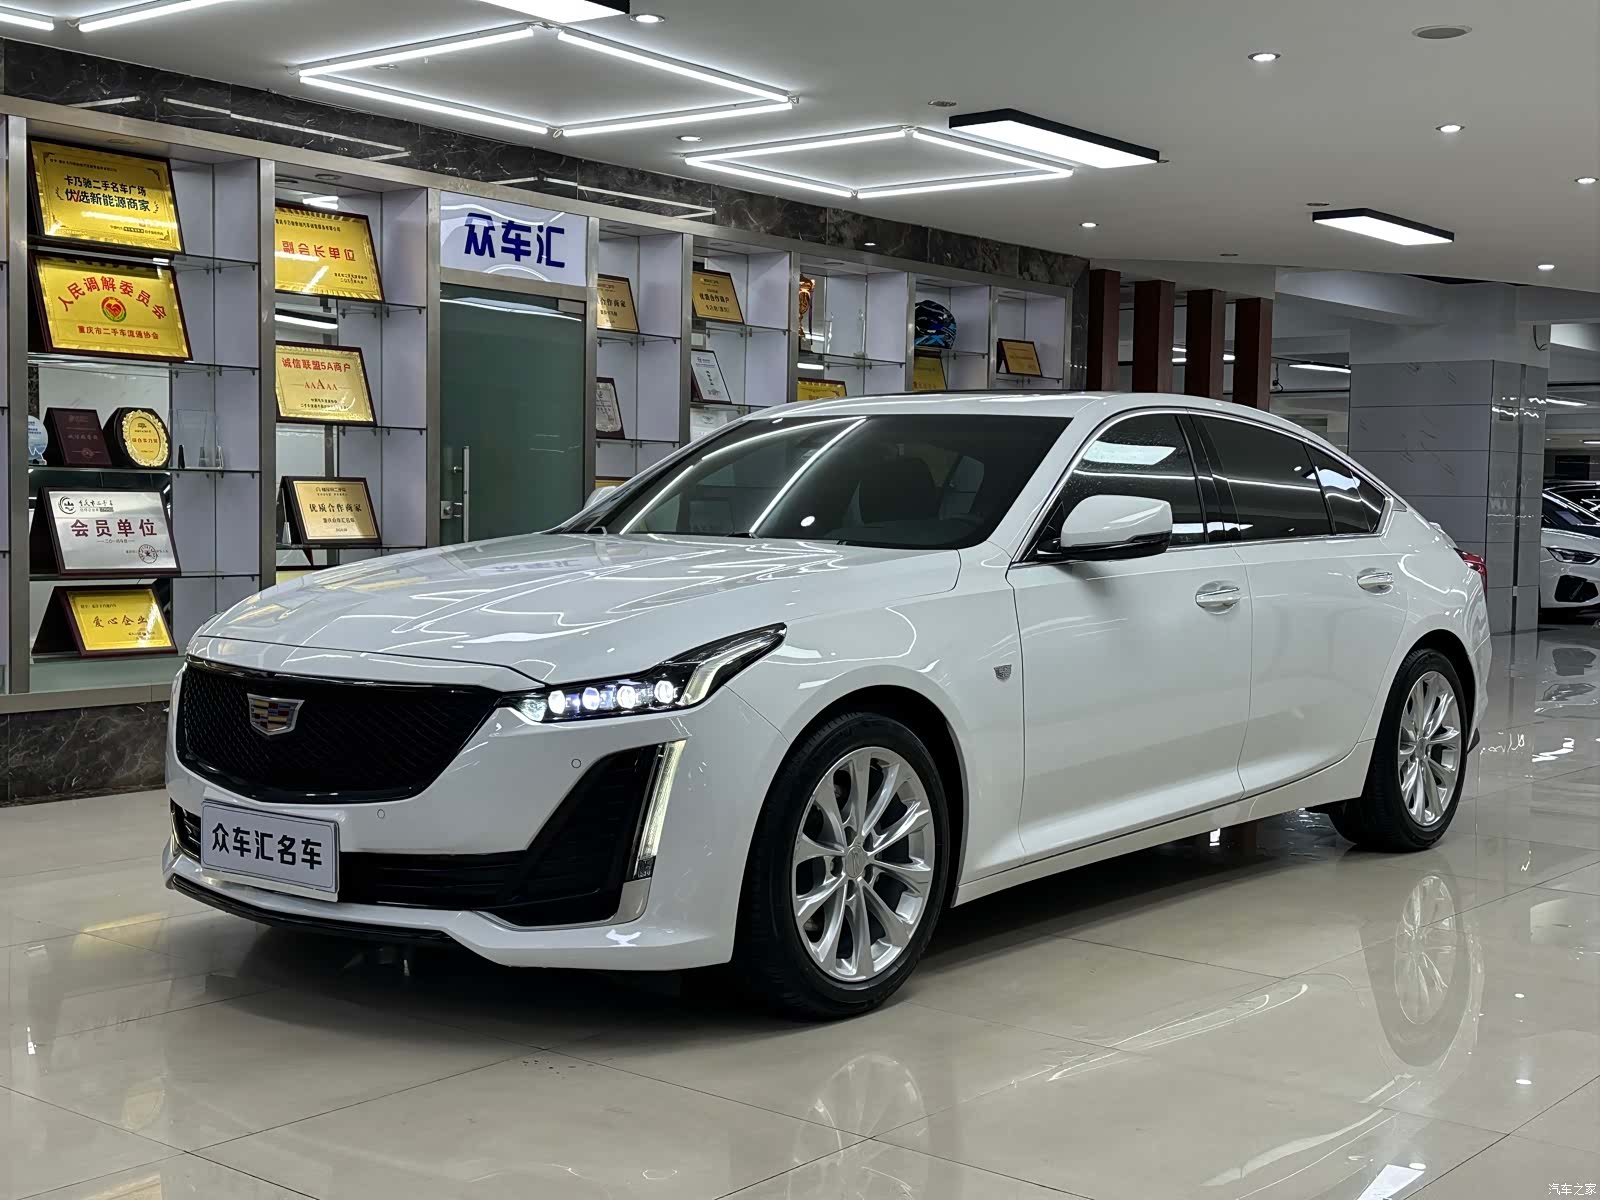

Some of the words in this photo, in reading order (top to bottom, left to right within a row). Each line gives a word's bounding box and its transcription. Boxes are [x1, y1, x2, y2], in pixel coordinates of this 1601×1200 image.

[64, 174, 146, 197] 卡乃驰二手名车广场
[65, 188, 150, 212] 优选新能源商家
[282, 240, 356, 262] 副会长单位
[464, 212, 565, 268] 众车汇
[58, 275, 167, 320] 人民调解委员会
[78, 325, 159, 340] 重庆市二手车流通协会
[282, 357, 351, 372] 诚信联盟5A商户
[309, 503, 362, 512] 优质合作商家
[70, 519, 157, 537] 会员单位
[212, 822, 322, 870] 众车汇名车
